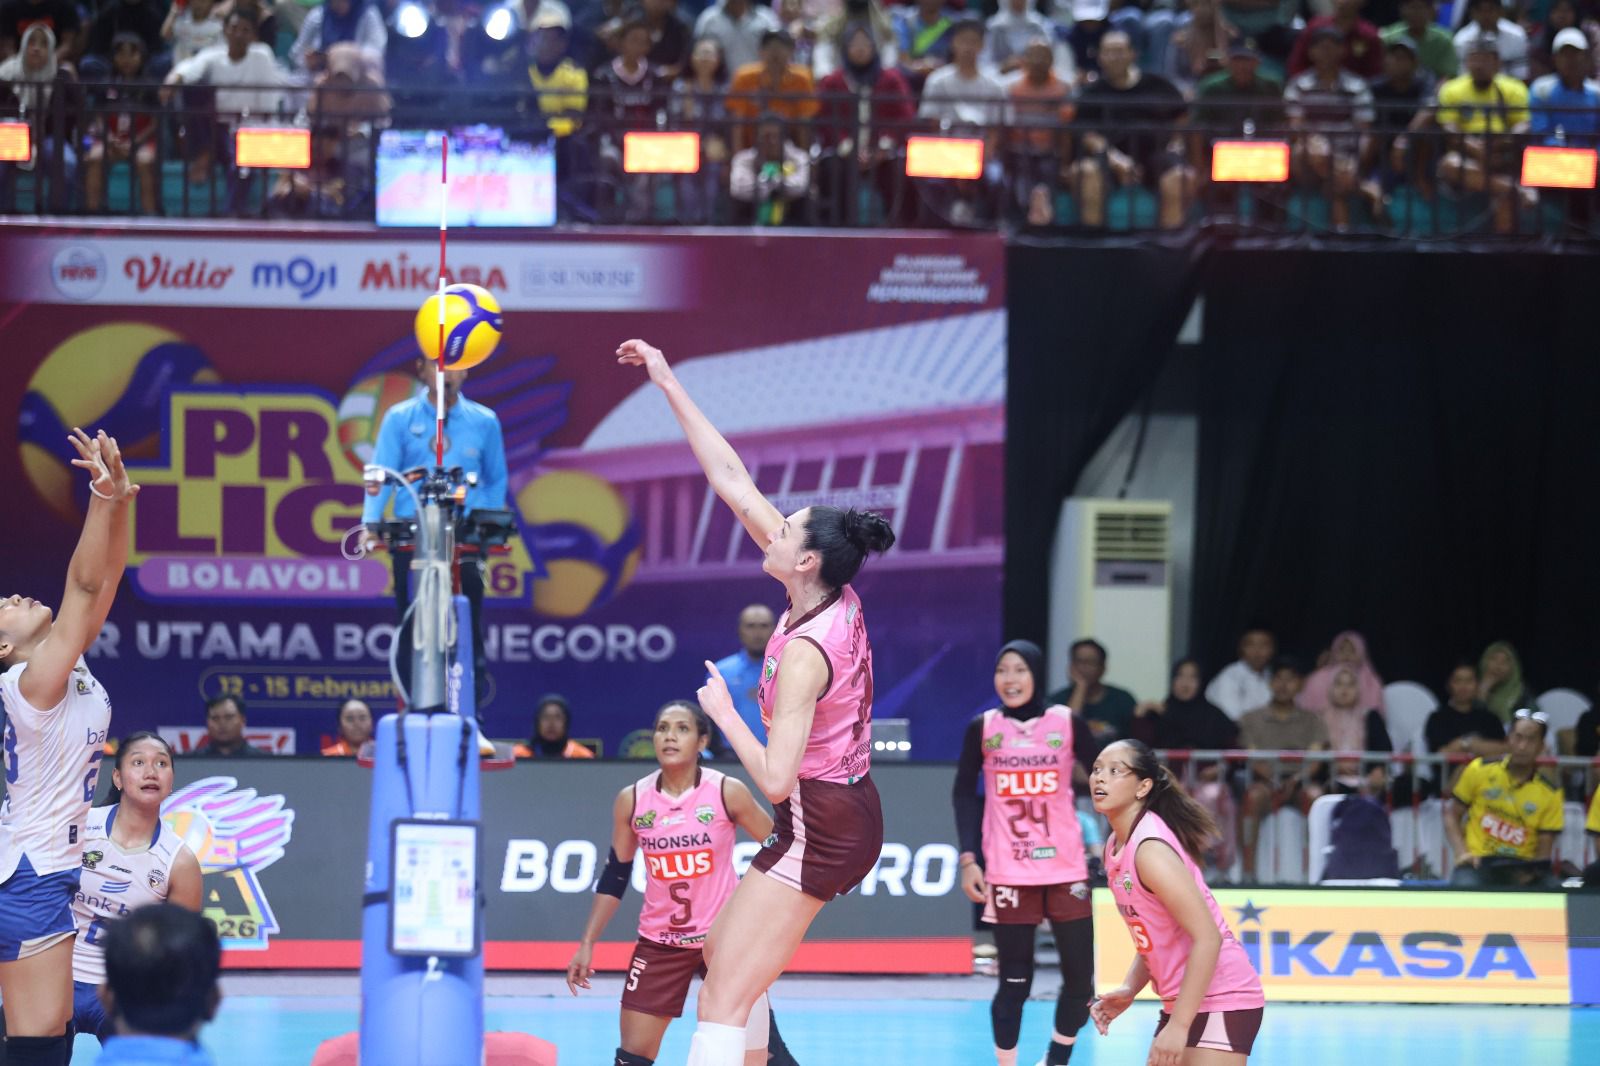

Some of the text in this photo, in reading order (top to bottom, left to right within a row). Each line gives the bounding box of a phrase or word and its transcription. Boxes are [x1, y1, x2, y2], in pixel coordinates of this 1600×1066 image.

[124, 253, 234, 291] Vidio
[135, 483, 366, 557] LIG
[167, 562, 361, 590] BOLAVOLI
[136, 621, 322, 660] UTAMA
[86, 728, 105, 746] ba
[993, 754, 1059, 768] PHONSKA
[996, 773, 1059, 795] PLUS
[1005, 799, 1051, 839] 24
[1481, 814, 1525, 845] PLUS
[641, 832, 712, 850] PHONSKA
[648, 851, 712, 878] PLUS
[1013, 849, 1030, 861] ZA
[75, 891, 112, 912] ank
[669, 881, 693, 926] 5
[995, 886, 1020, 908] 24
[219, 918, 256, 938] 26
[1232, 898, 1537, 980] IKASA
[627, 967, 642, 992] 5
